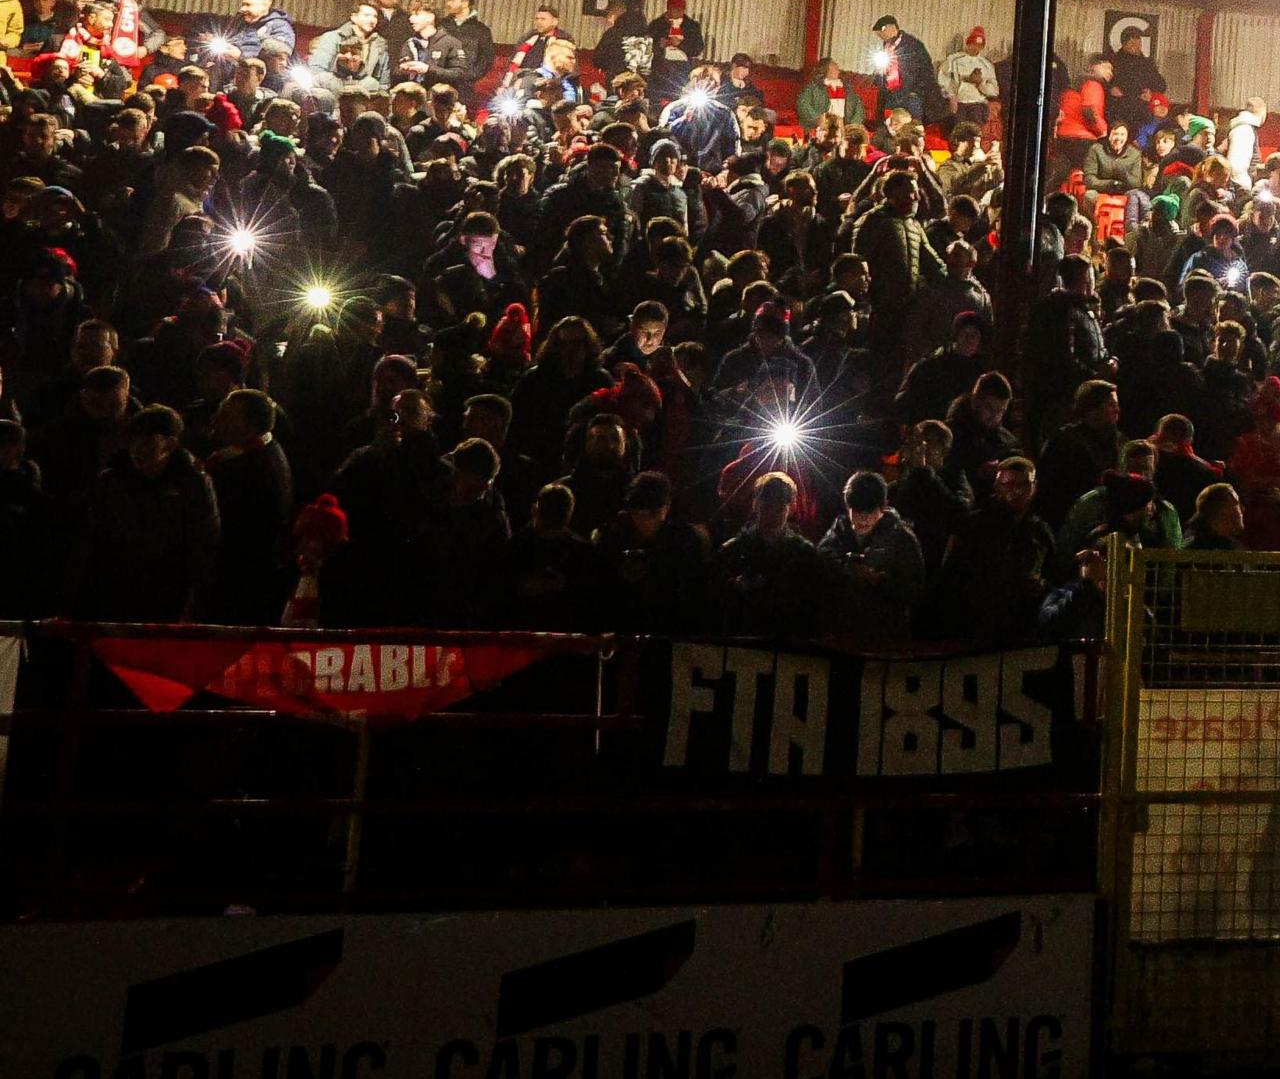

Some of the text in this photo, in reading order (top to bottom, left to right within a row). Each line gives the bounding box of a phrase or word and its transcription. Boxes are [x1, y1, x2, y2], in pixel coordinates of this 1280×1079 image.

[1109, 16, 1151, 58] G
[662, 641, 1060, 776] FTA 1895
[785, 1013, 1064, 1079] CARLING
